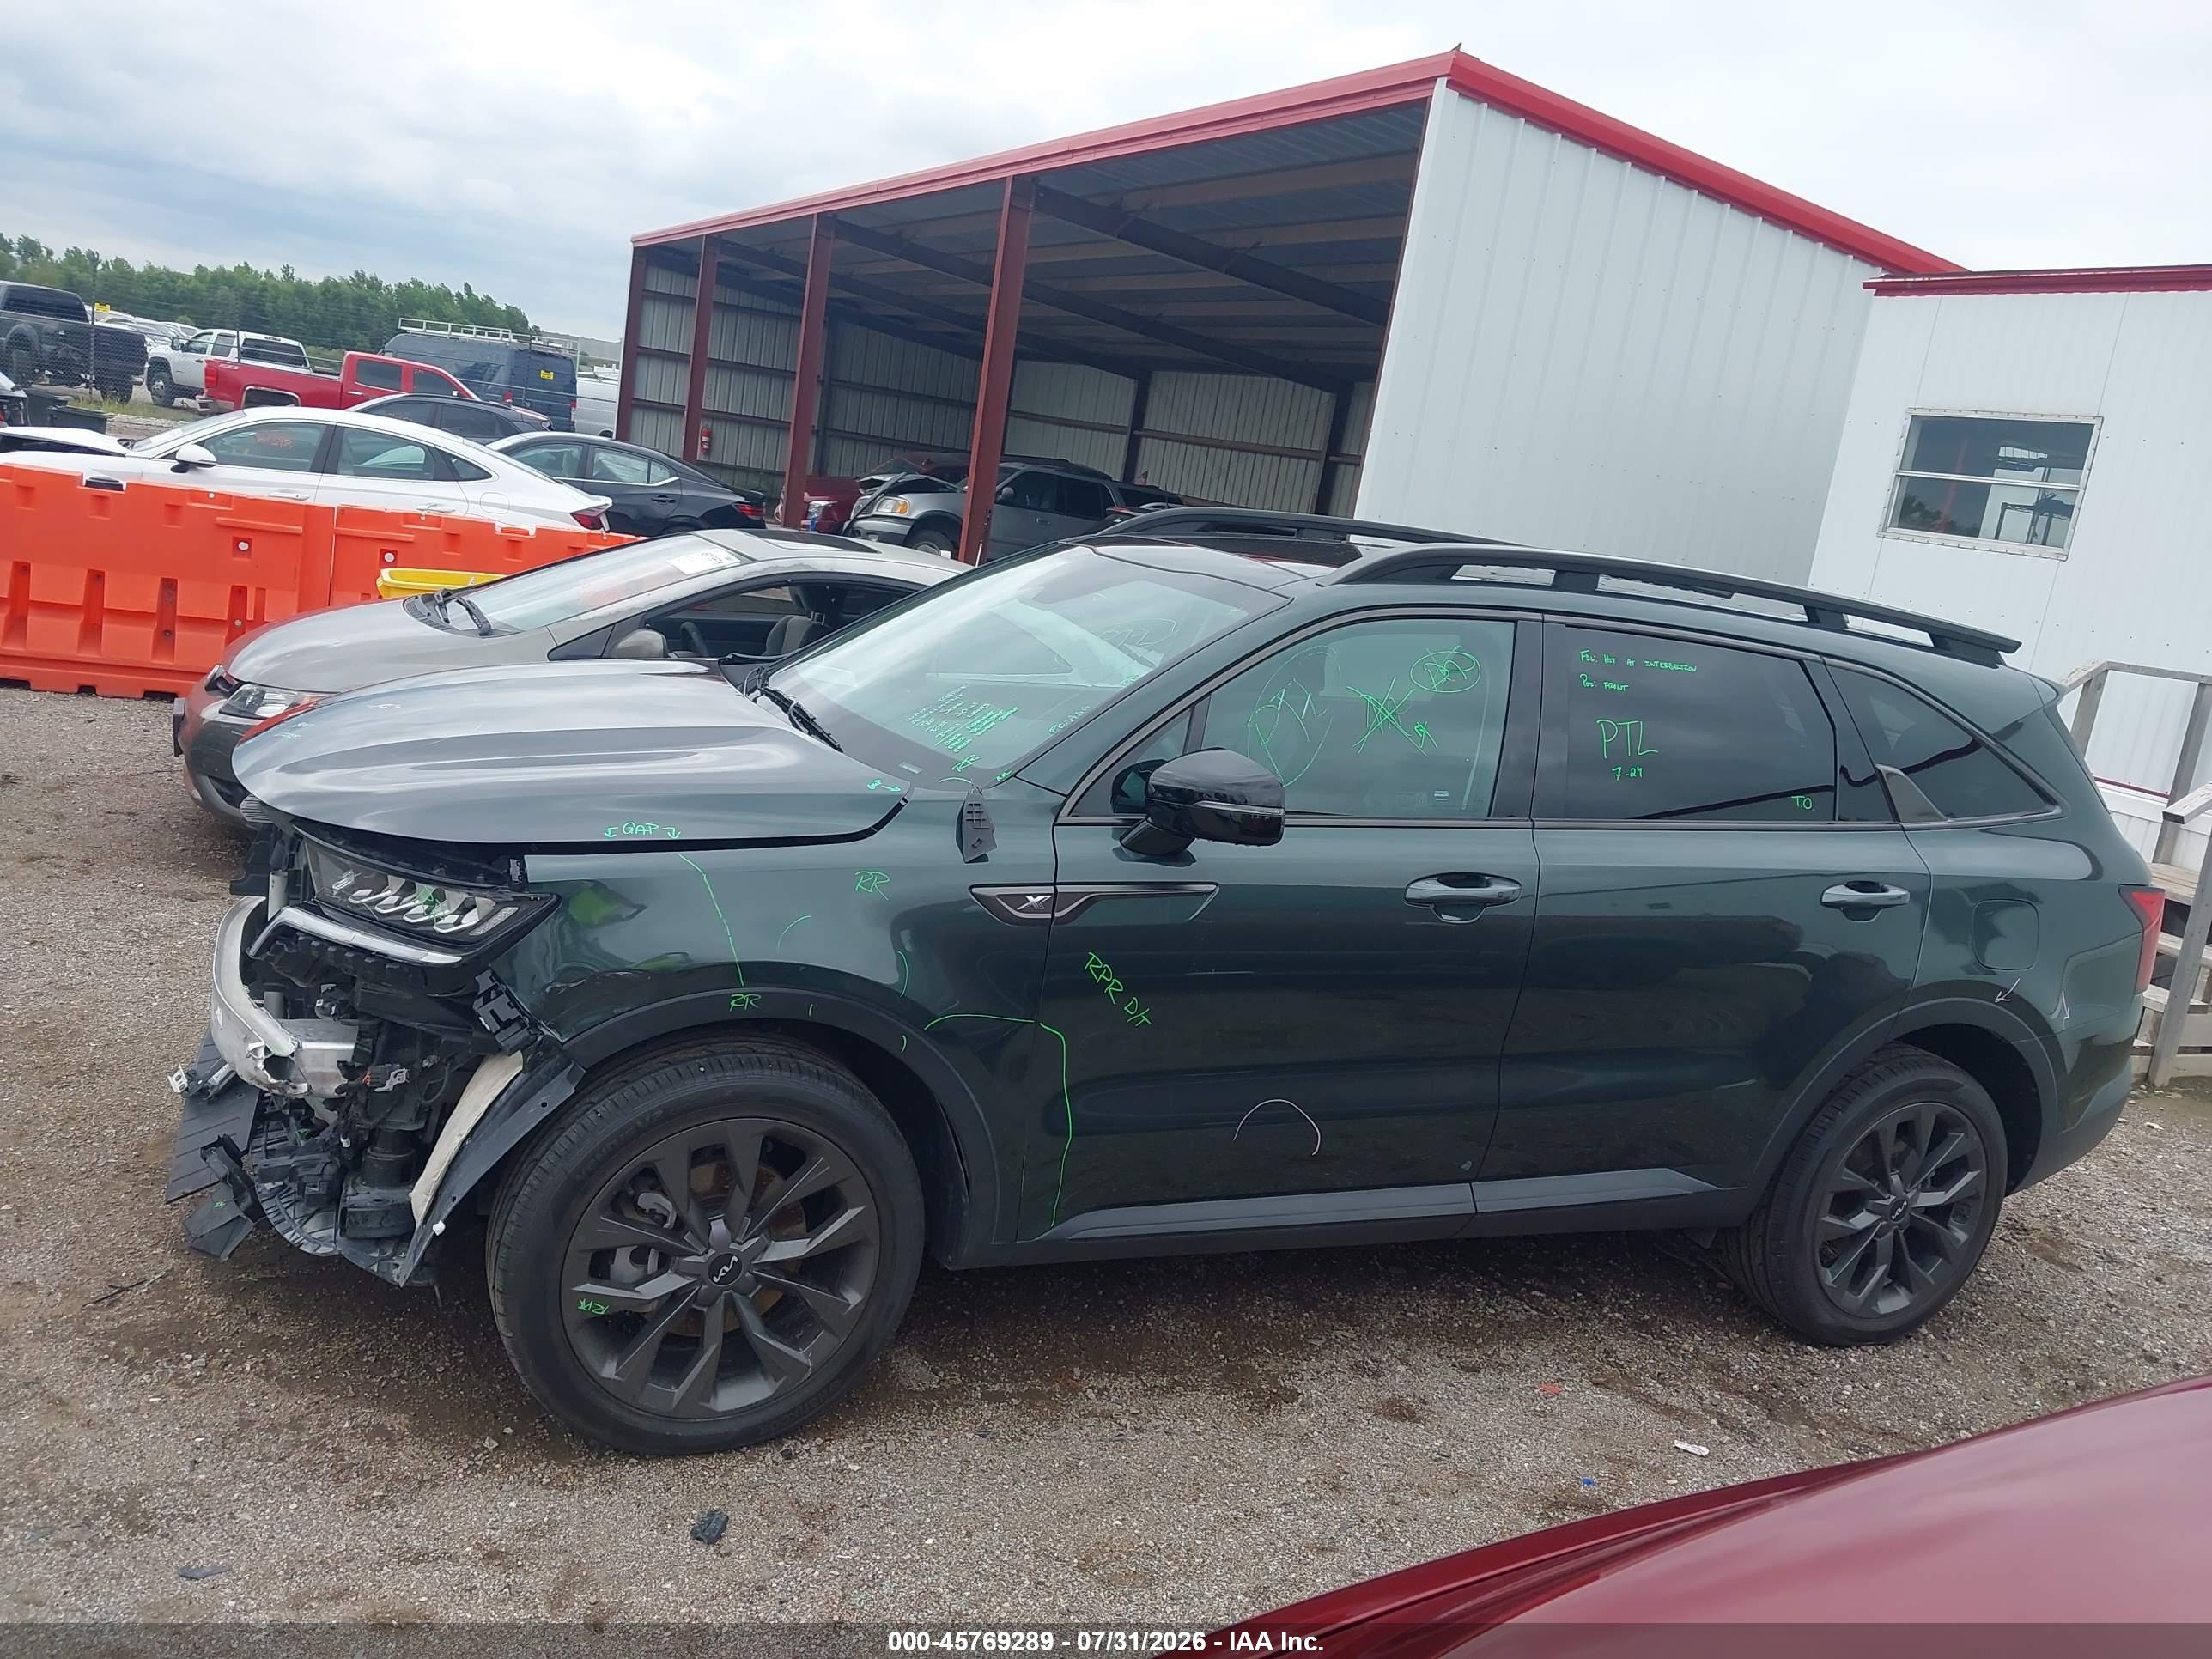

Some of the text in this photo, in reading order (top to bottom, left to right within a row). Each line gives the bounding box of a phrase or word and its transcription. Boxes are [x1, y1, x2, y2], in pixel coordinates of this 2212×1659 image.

[1596, 718, 1659, 759] PTL
[1611, 765, 1644, 781] 7-24
[622, 821, 660, 836] GAP
[854, 870, 890, 901] RR
